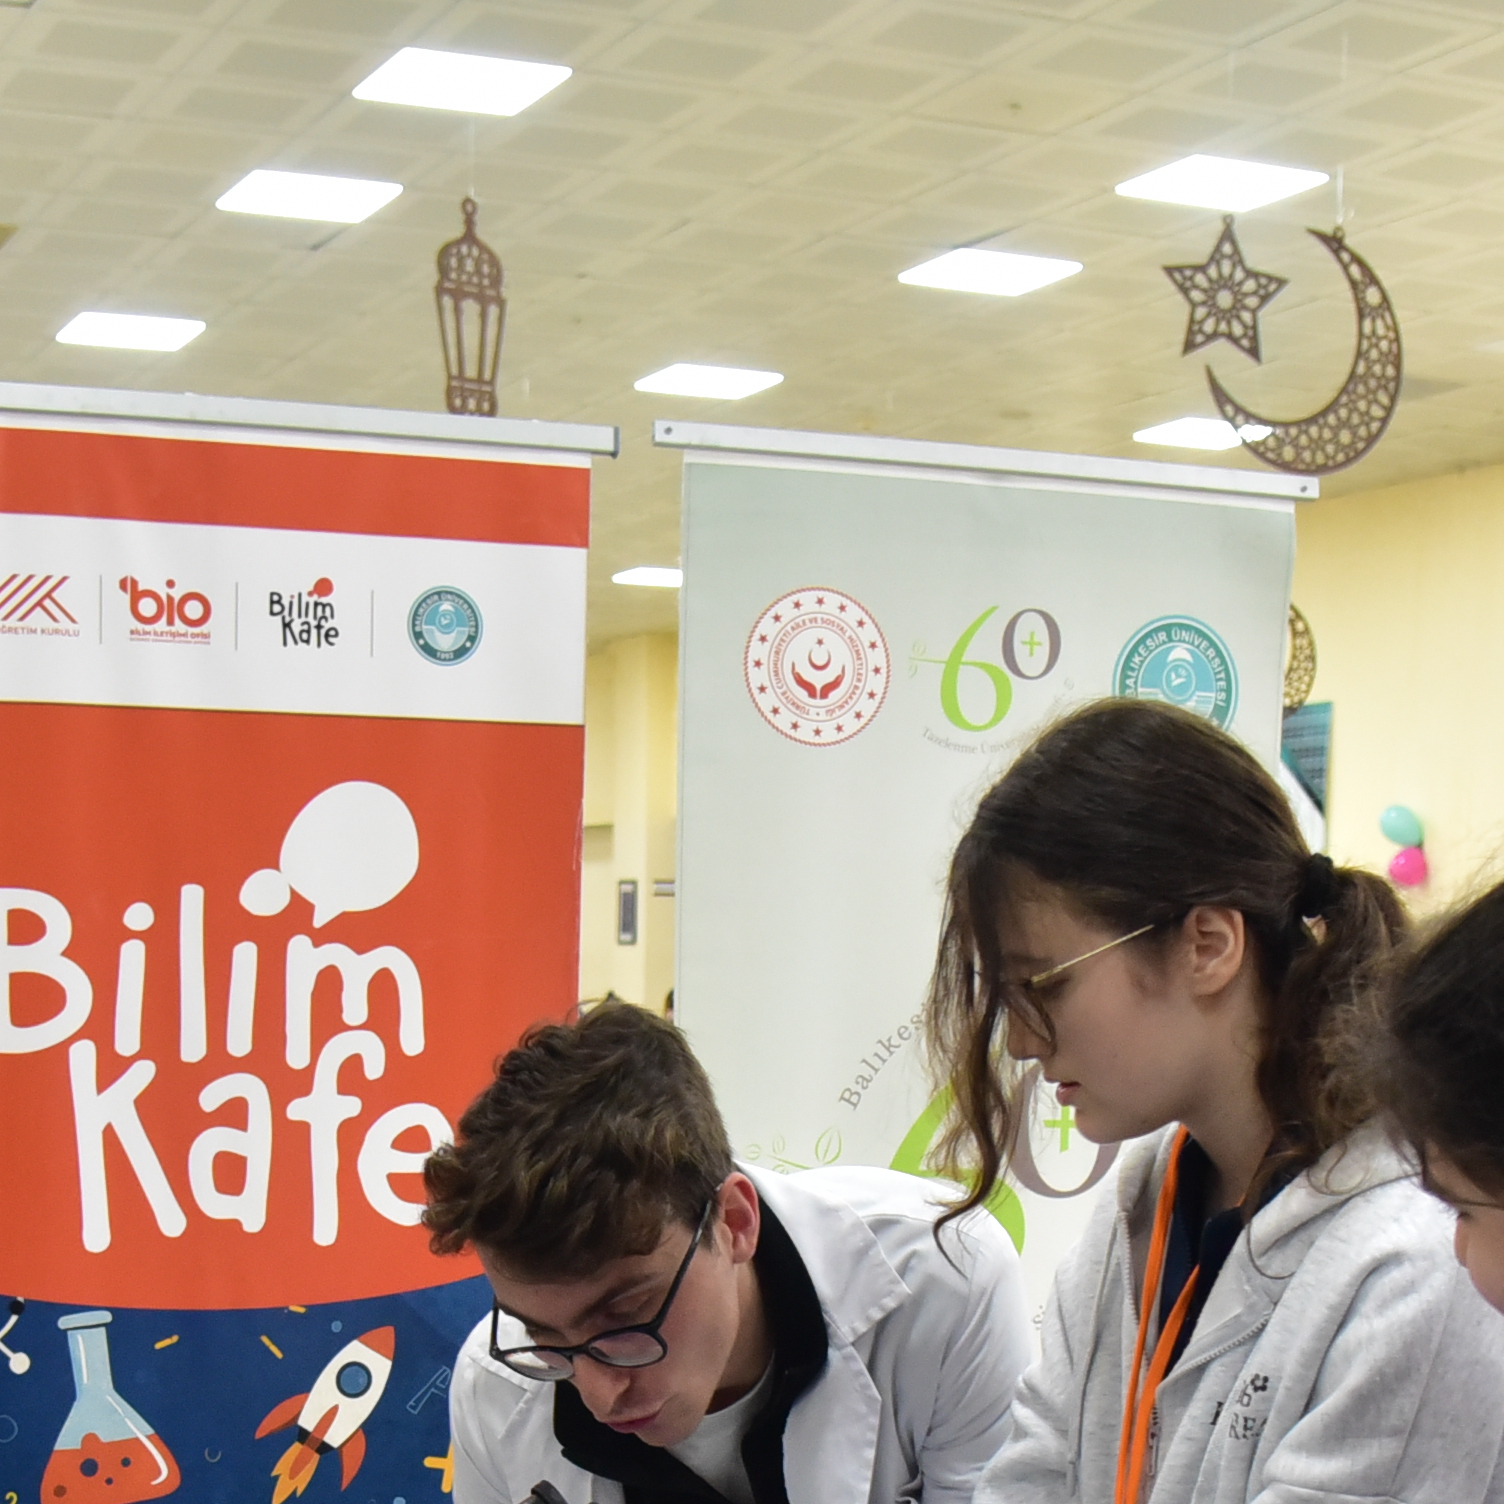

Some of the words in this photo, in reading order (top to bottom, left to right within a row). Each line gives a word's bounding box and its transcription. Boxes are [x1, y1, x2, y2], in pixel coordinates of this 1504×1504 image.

[118, 575, 212, 628] bio
[269, 590, 334, 620] Bilim
[40, 627, 80, 638] KURULU
[282, 615, 339, 648] Kafe
[808, 616, 818, 625] VE
[1172, 630, 1228, 707] ÜNİVERSİTESİ
[68, 1029, 456, 1254] Kafe
